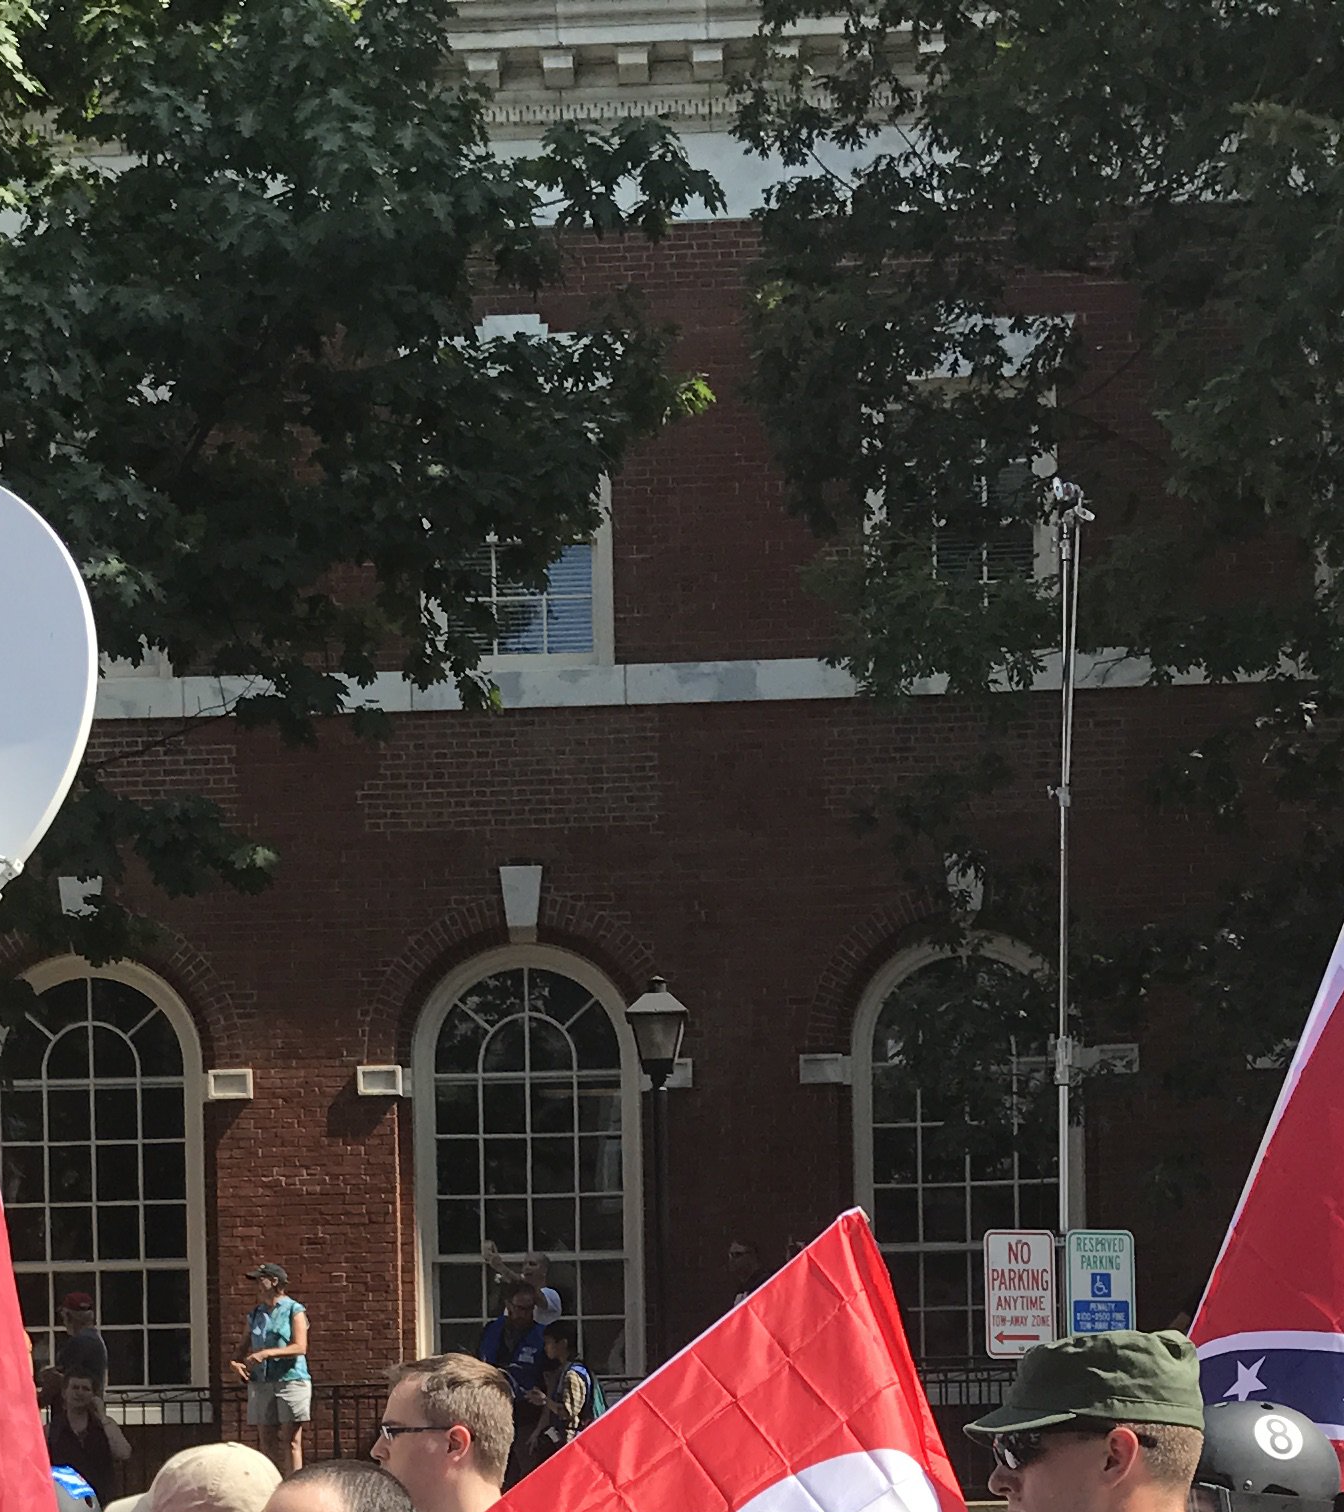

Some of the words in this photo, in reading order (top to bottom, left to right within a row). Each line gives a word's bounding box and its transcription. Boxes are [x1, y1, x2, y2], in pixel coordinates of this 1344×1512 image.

[1076, 1236, 1125, 1253] RESERVED
[1008, 1241, 1031, 1265] NO
[1080, 1255, 1121, 1271] PARKING
[991, 1268, 1049, 1291] PARKING
[996, 1295, 1045, 1311] ANYTIME
[1089, 1302, 1116, 1311] PENALTY
[992, 1314, 1029, 1327] TOW-AWAY
[1031, 1314, 1051, 1327] ZONE
[1112, 1312, 1126, 1321] FINE
[1266, 1418, 1293, 1455] 8
